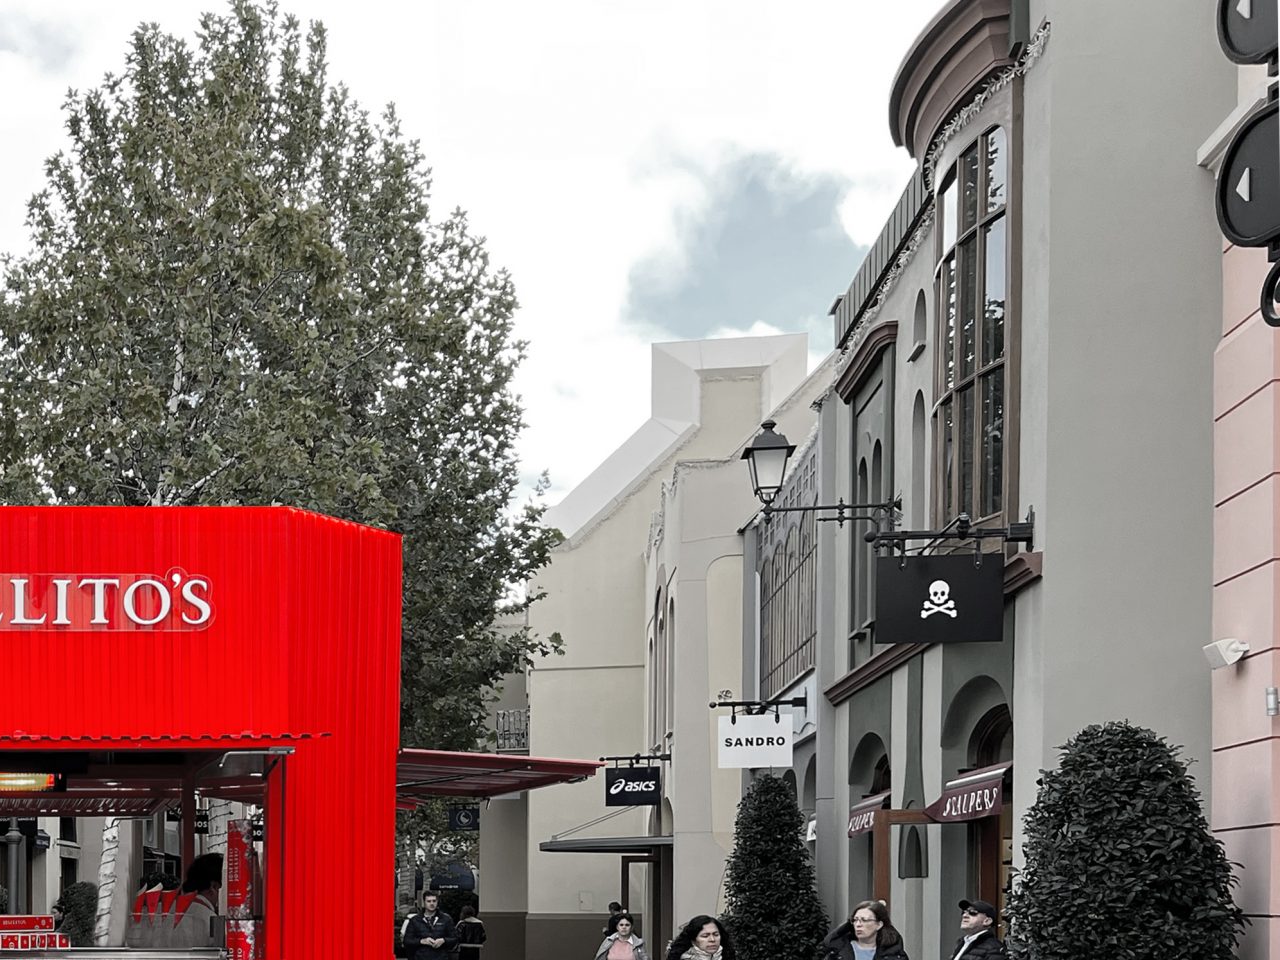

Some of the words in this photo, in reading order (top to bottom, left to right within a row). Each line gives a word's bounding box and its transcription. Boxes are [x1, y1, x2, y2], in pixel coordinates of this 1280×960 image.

[724, 736, 786, 748] SANDRO
[624, 779, 656, 792] asics
[942, 786, 999, 817] SCALPERS
[848, 811, 875, 832] SCALPER
